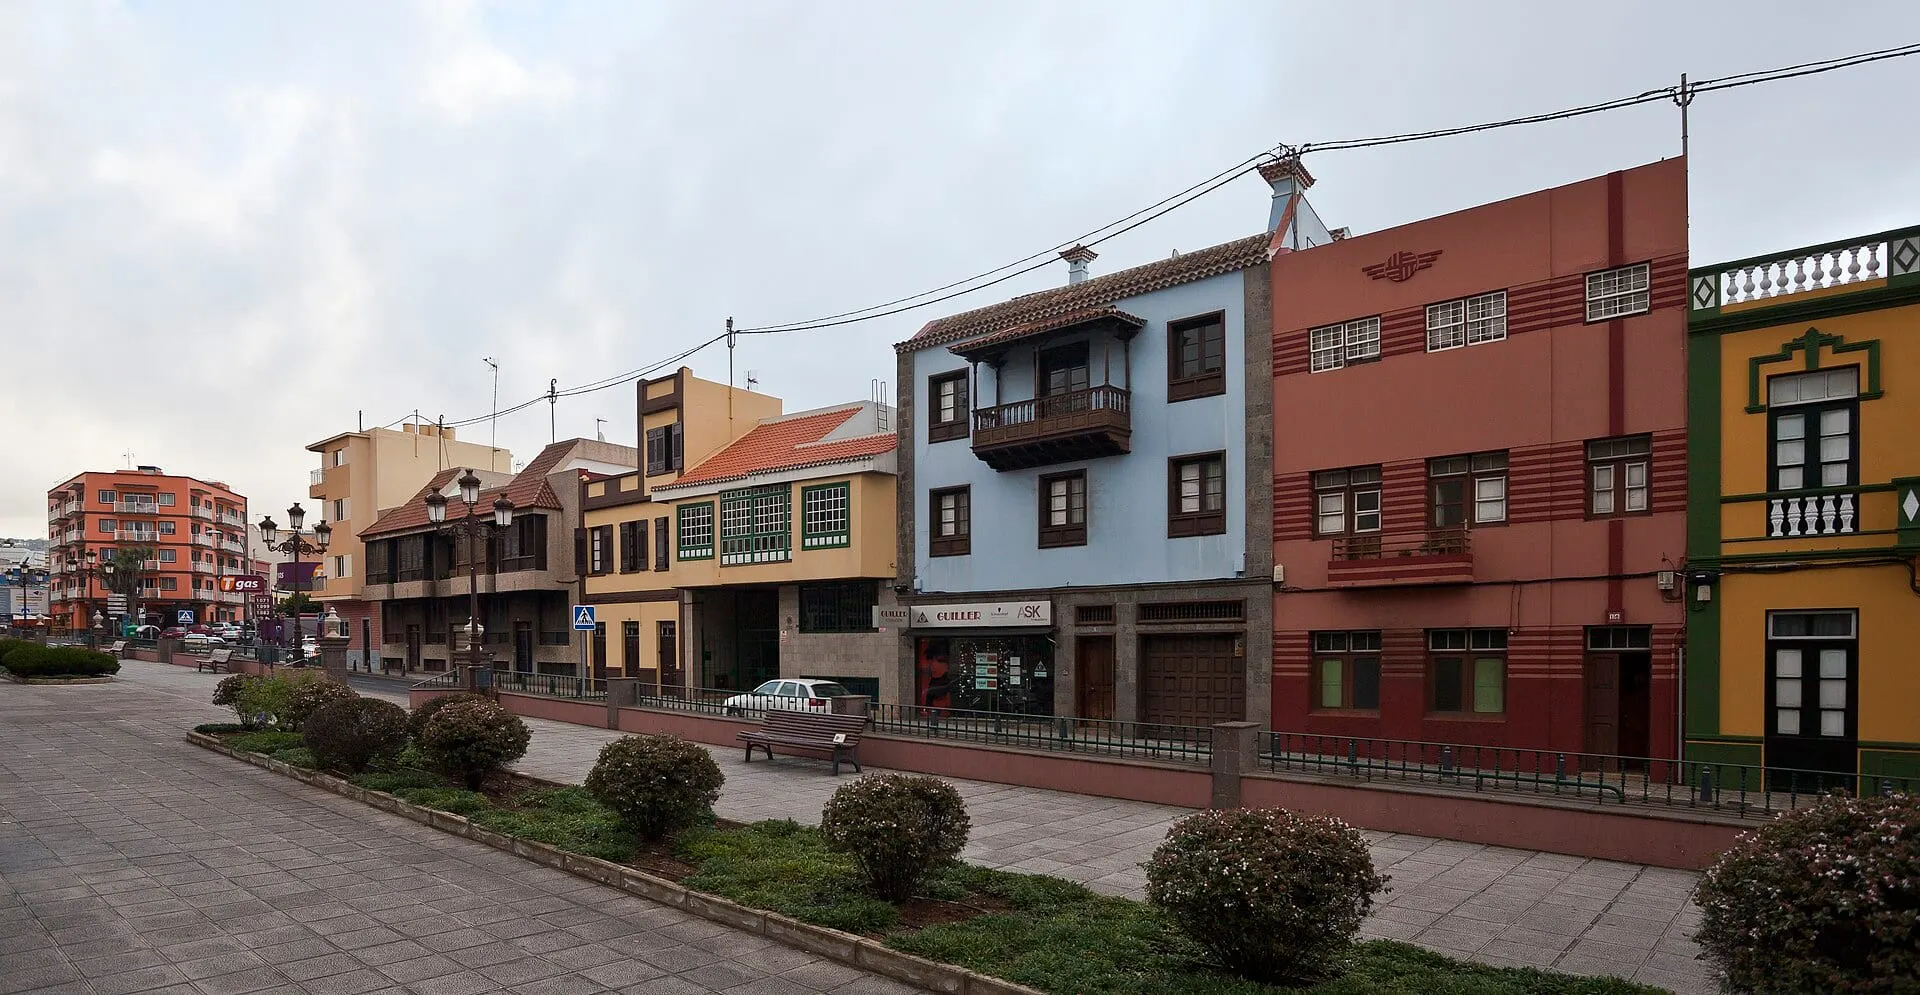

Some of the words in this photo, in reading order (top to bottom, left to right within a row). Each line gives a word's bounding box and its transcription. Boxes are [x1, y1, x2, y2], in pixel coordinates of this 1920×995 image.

[236, 580, 258, 590] gas
[881, 610, 907, 618] GUILLER
[937, 611, 982, 621] GUILLER
[1017, 605, 1041, 619] ASK
